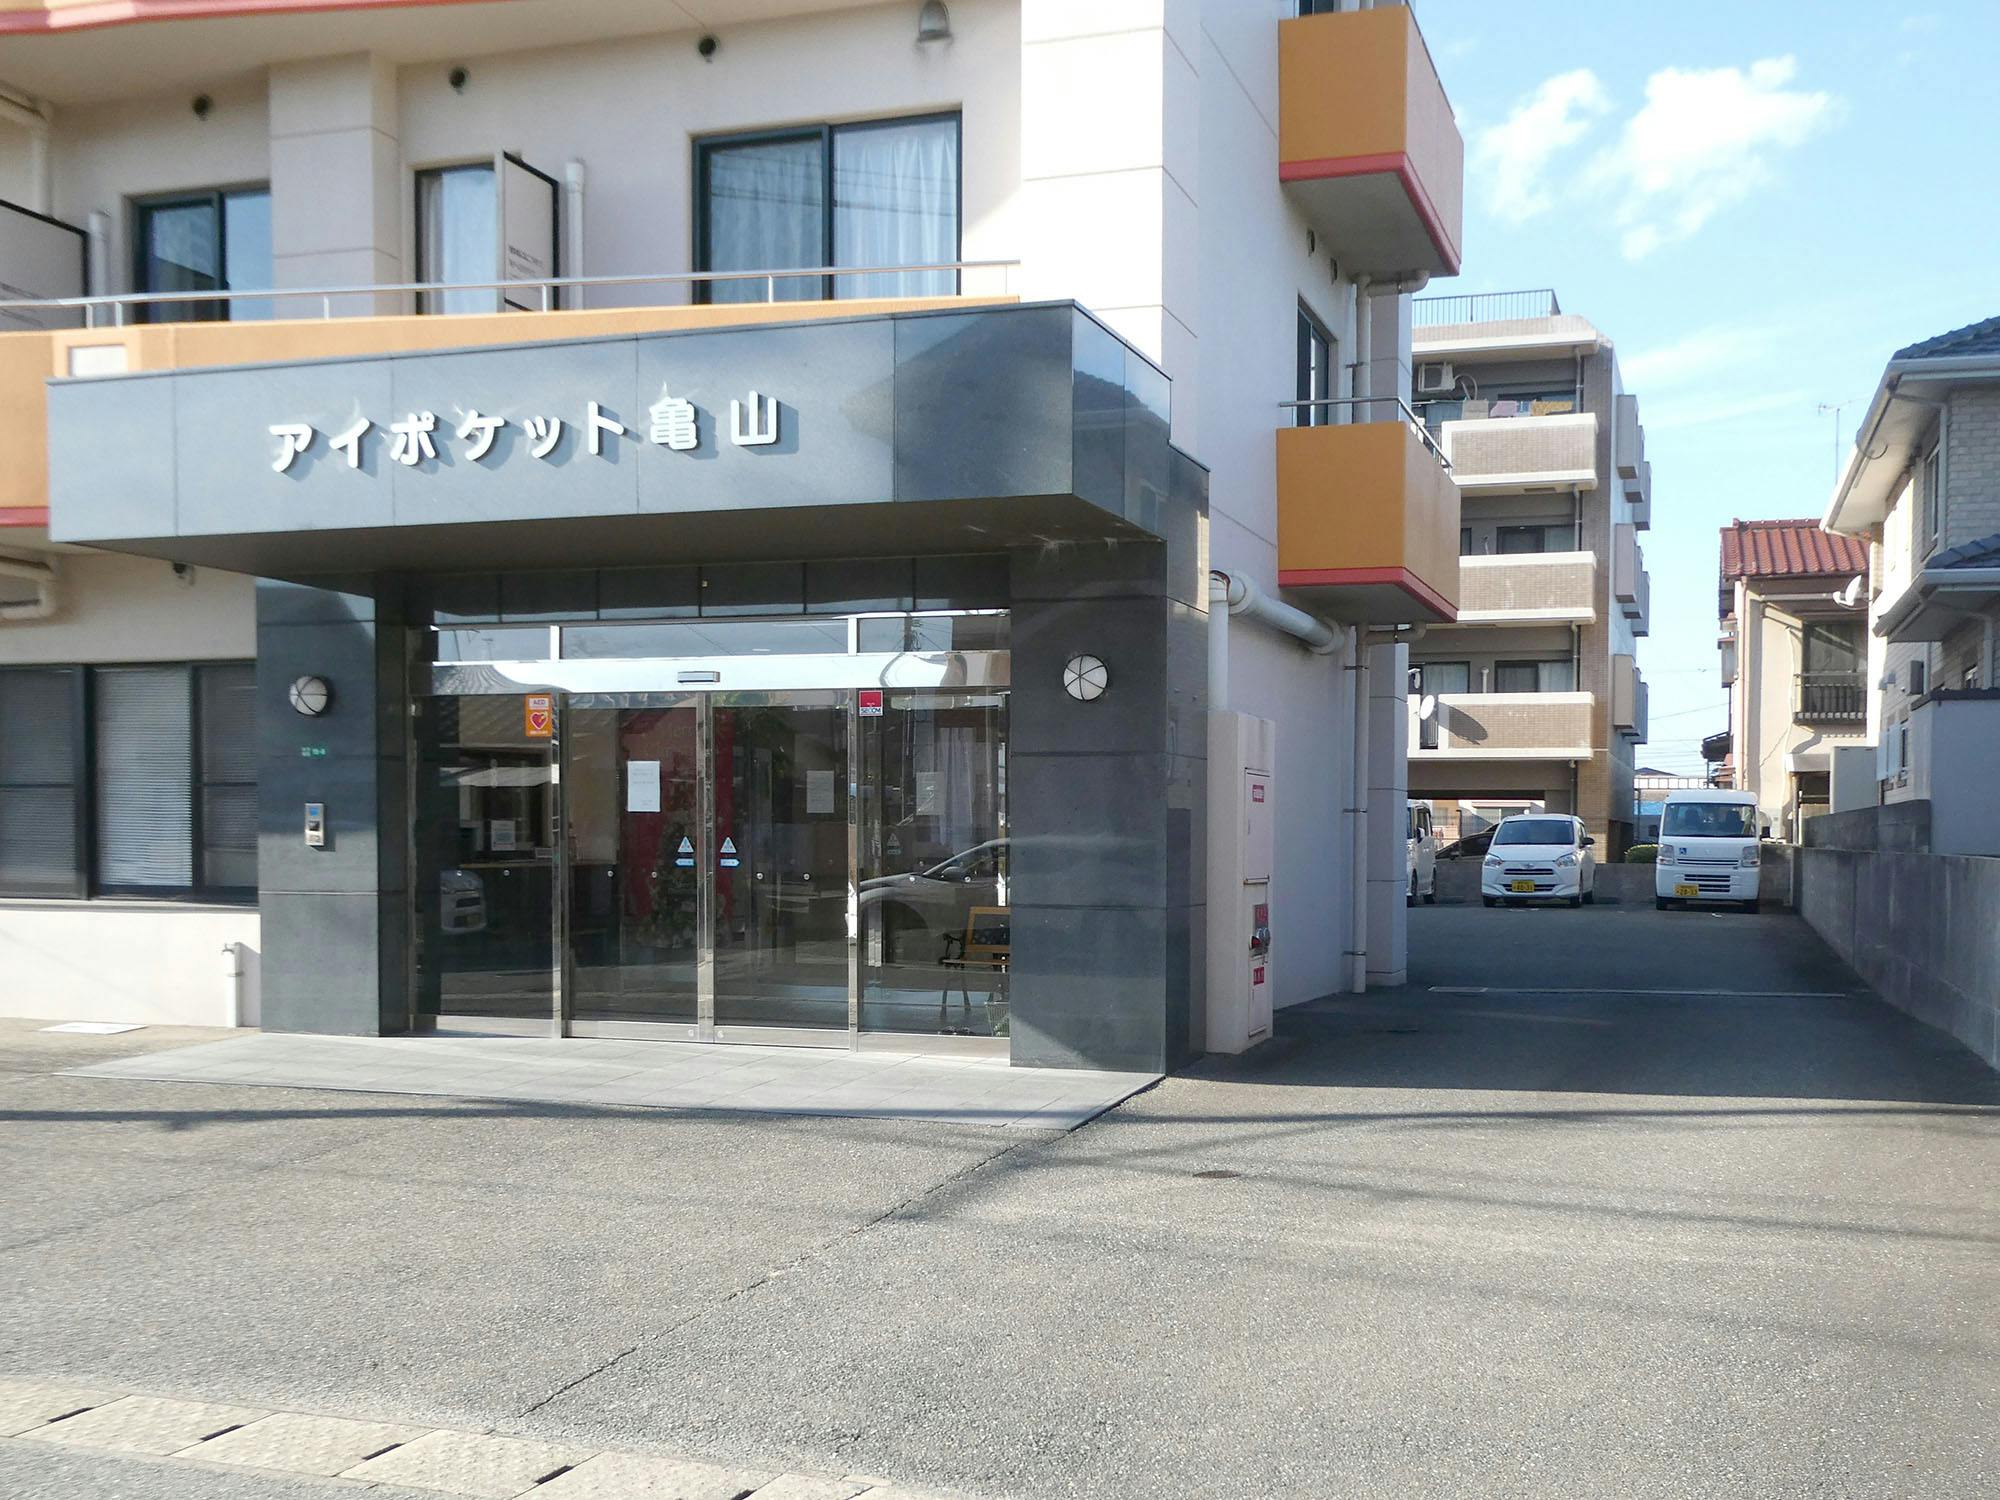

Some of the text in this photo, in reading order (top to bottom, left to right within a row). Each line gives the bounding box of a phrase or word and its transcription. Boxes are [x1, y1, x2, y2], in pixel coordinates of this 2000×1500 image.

[268, 390, 778, 473] アイポケット亀山
